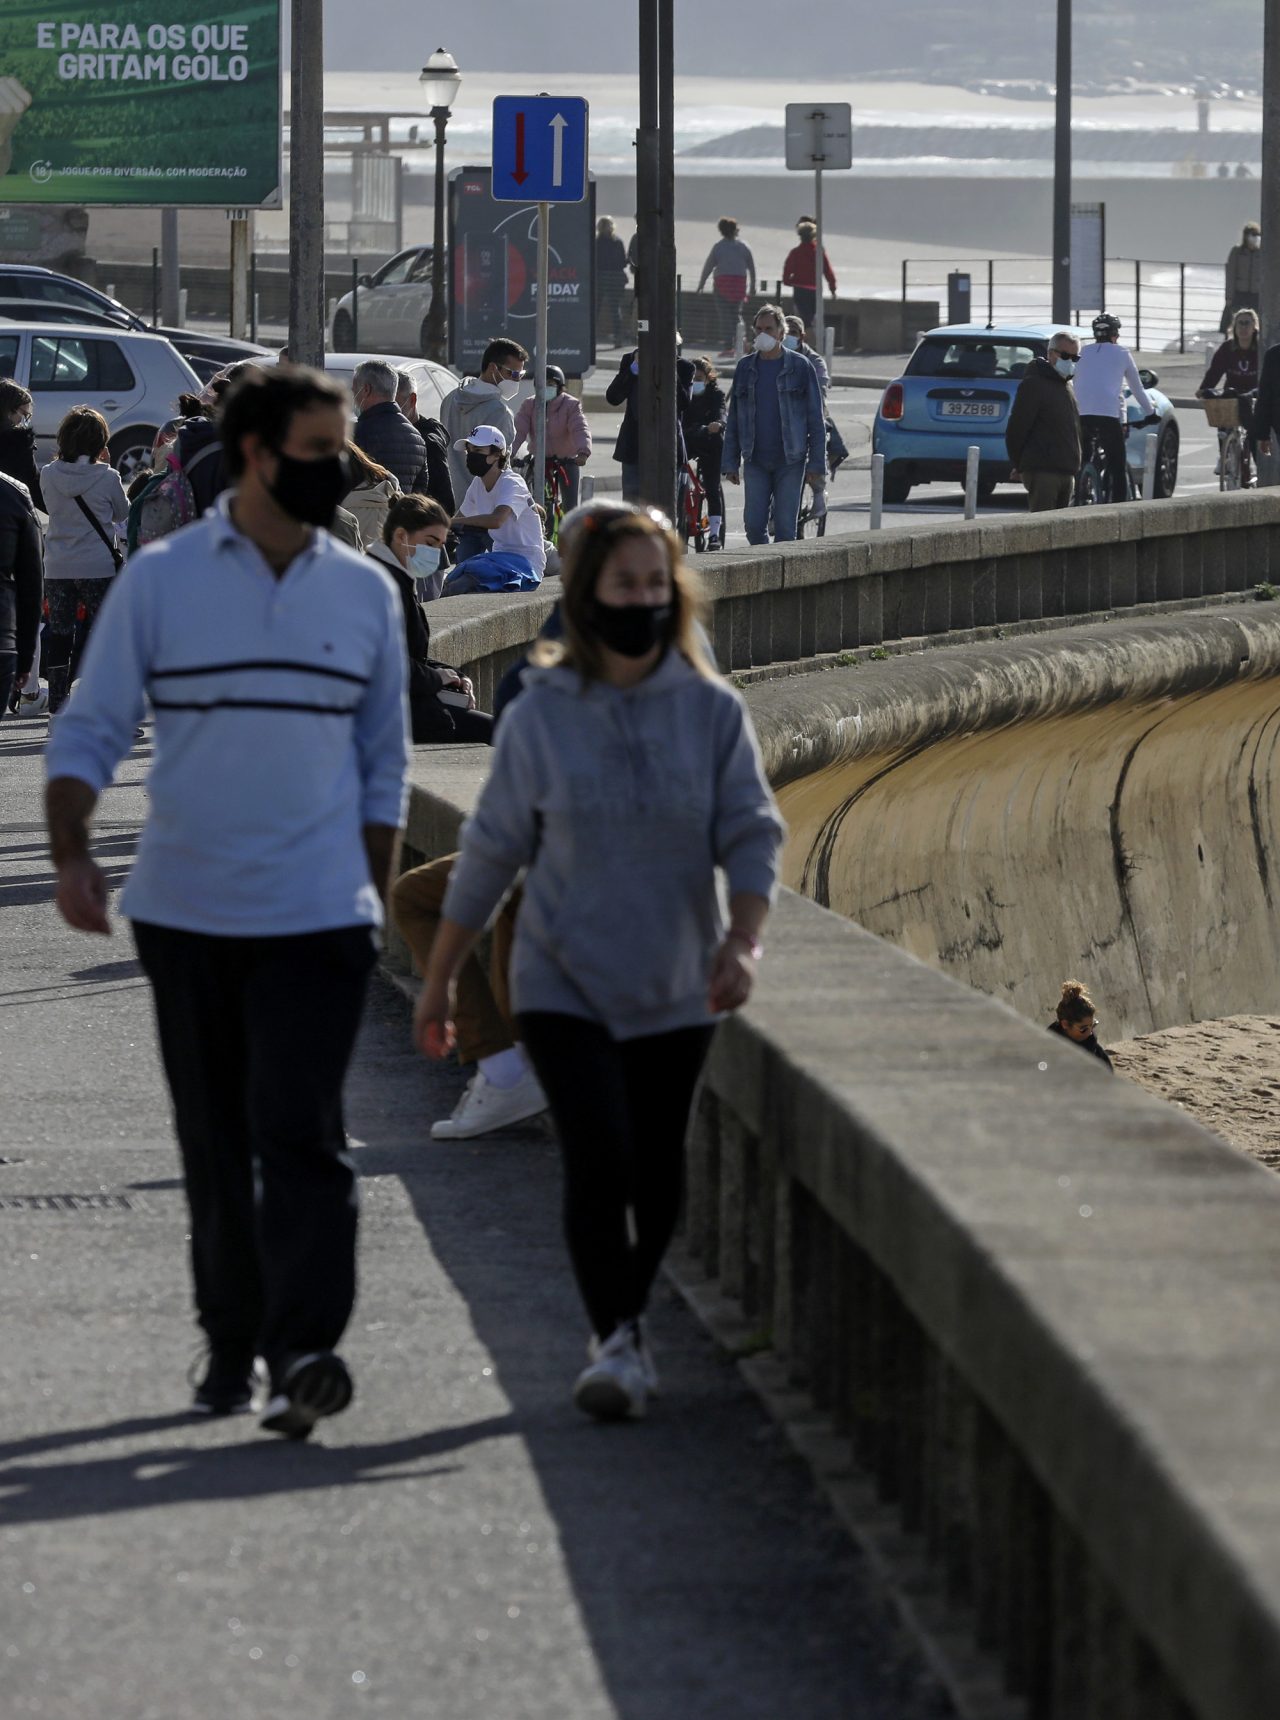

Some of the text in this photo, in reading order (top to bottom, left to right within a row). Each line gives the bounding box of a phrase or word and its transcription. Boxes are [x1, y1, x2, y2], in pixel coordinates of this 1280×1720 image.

[37, 22, 248, 52] E PARA OS QUE
[58, 54, 248, 81] GRITAM GOLO
[59, 165, 247, 179] JOGUE POR DIVERSÃO, COM MODERAÇÃO
[531, 283, 580, 295] FIDAY
